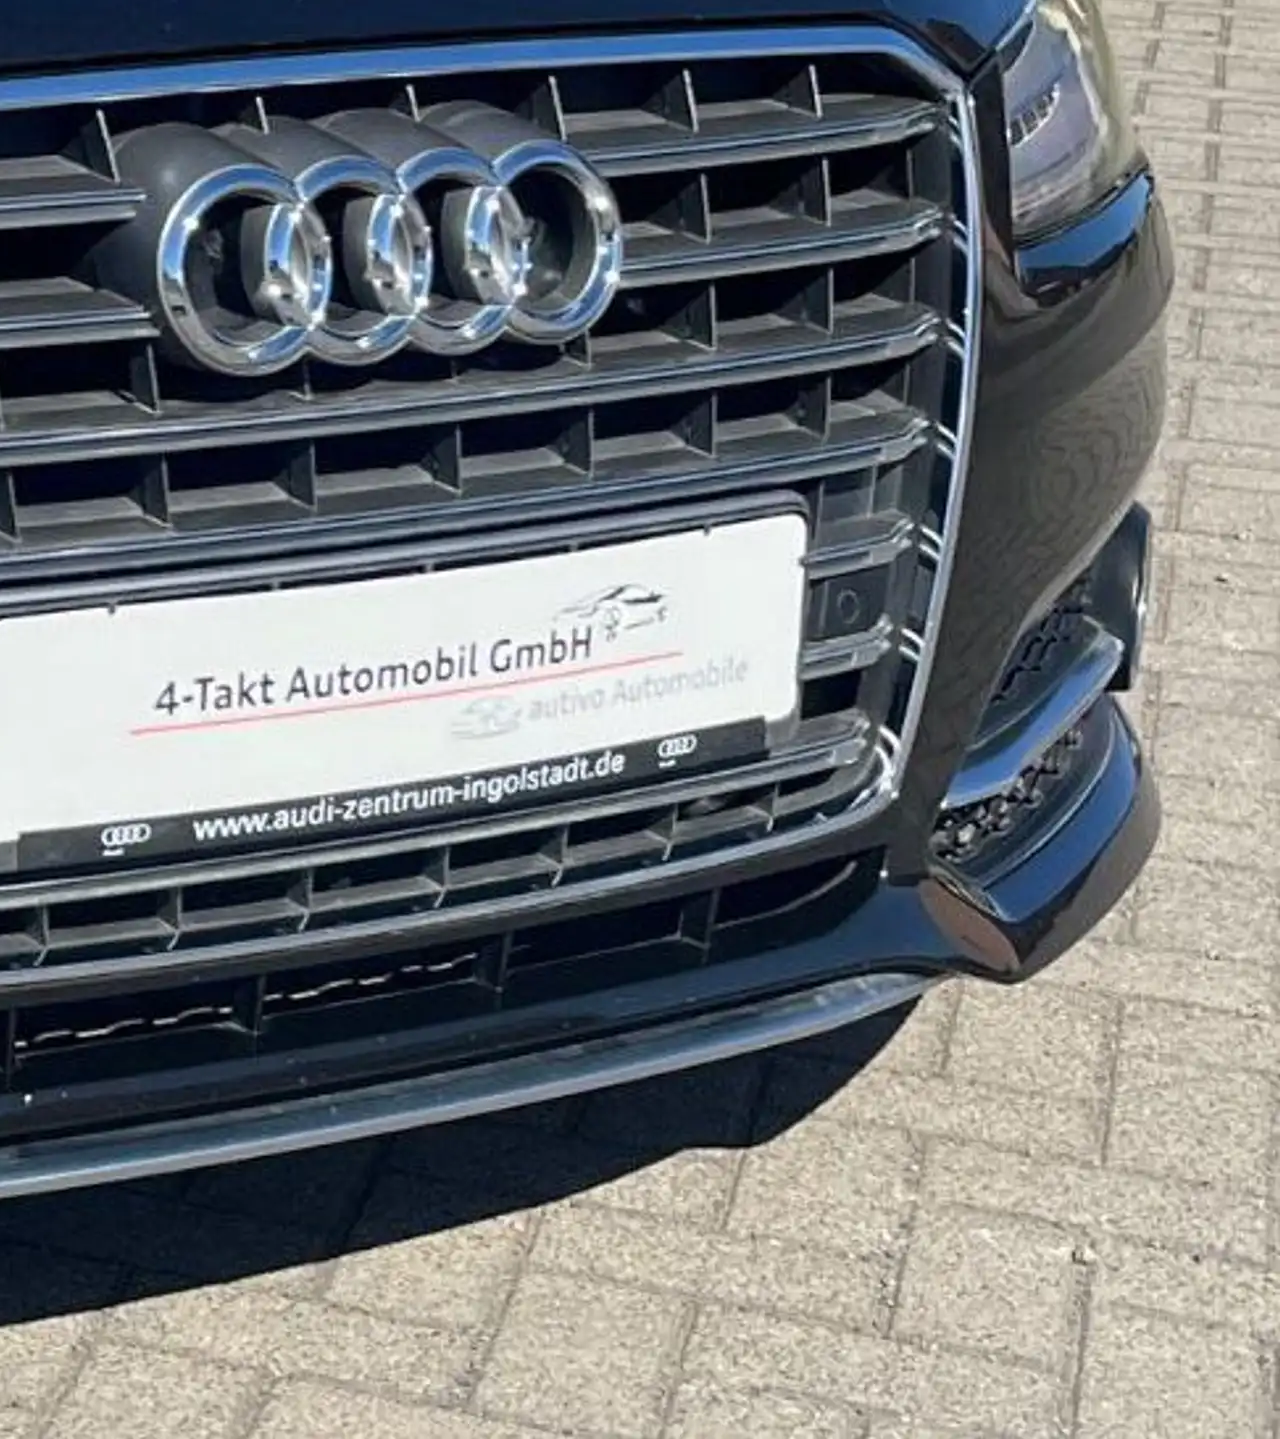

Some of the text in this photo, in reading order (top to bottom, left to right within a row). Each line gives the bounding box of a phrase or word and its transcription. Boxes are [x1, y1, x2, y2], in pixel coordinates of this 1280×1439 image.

[154, 628, 592, 716] 4-Takt Automobil GmbH
[192, 749, 626, 842] www.audi-zentrum-ingolstadt.de
